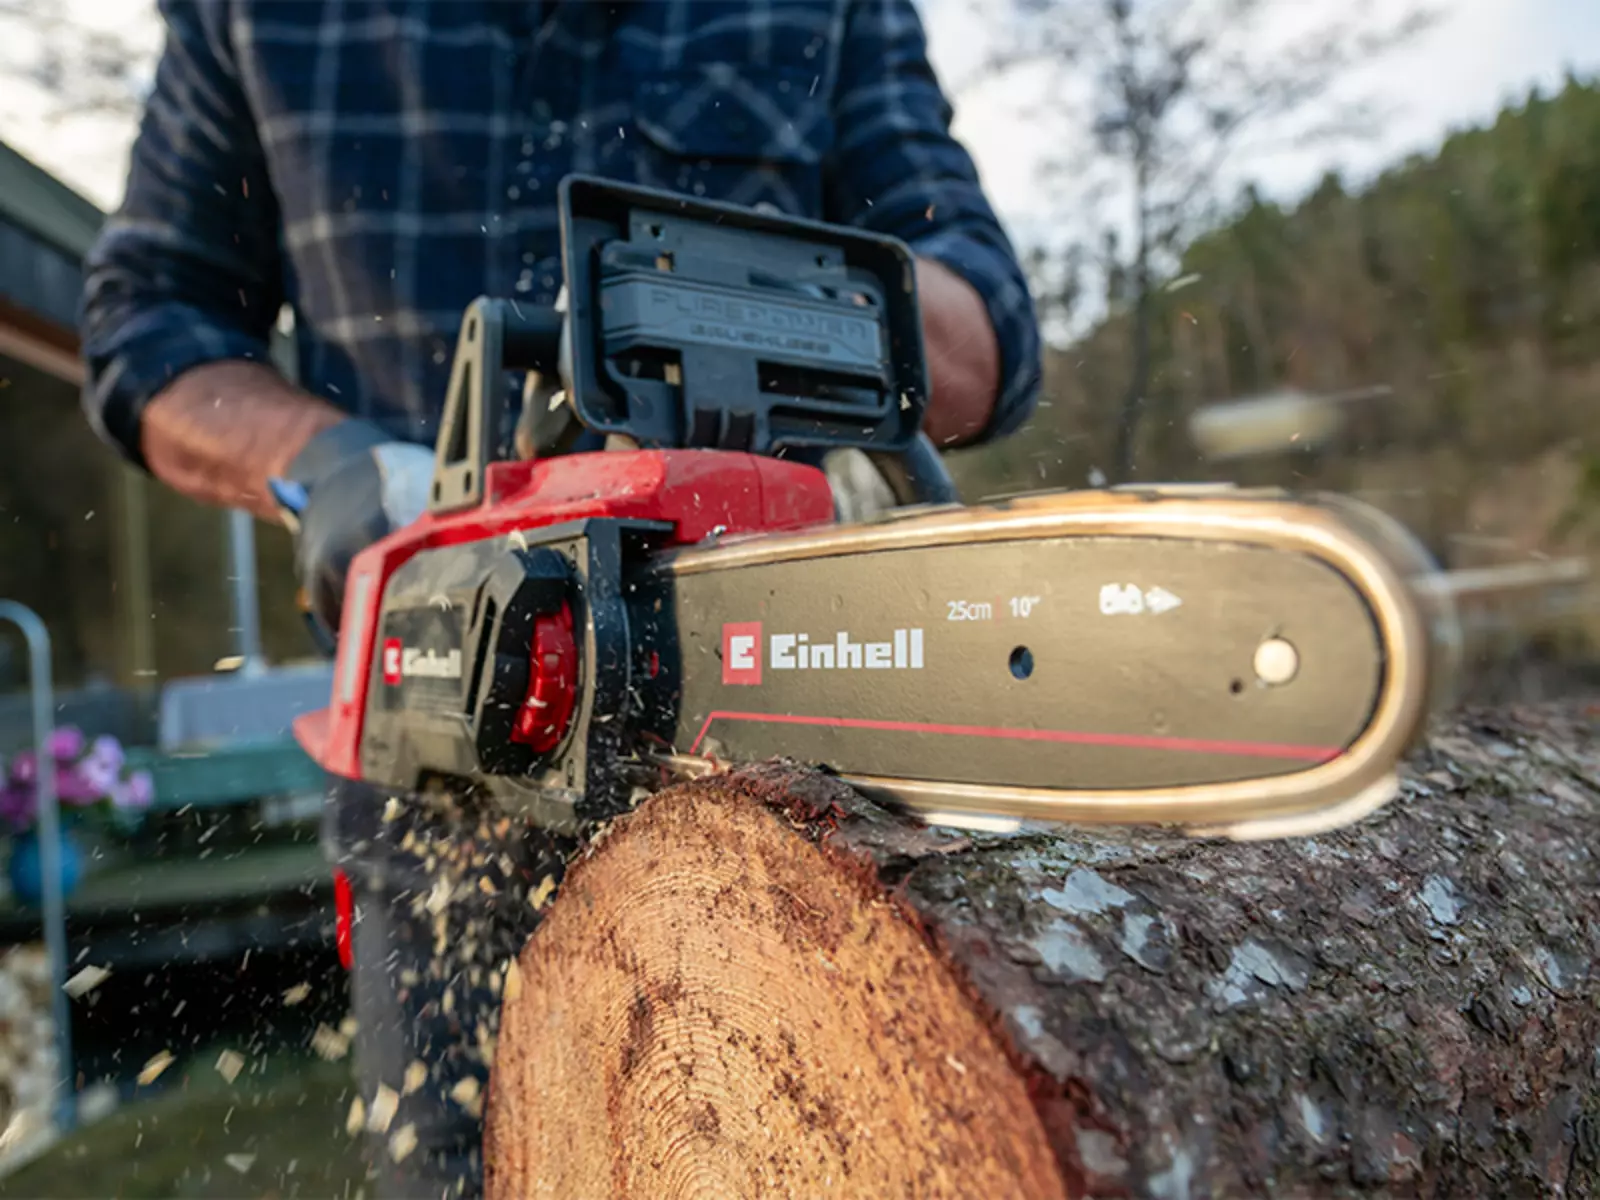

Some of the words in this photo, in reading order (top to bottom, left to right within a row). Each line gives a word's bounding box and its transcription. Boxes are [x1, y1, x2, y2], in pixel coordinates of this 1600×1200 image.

[651, 288, 868, 340] PUREPOWER
[947, 601, 992, 620] 25cm
[730, 636, 754, 669] E
[770, 628, 924, 669] Einhell
